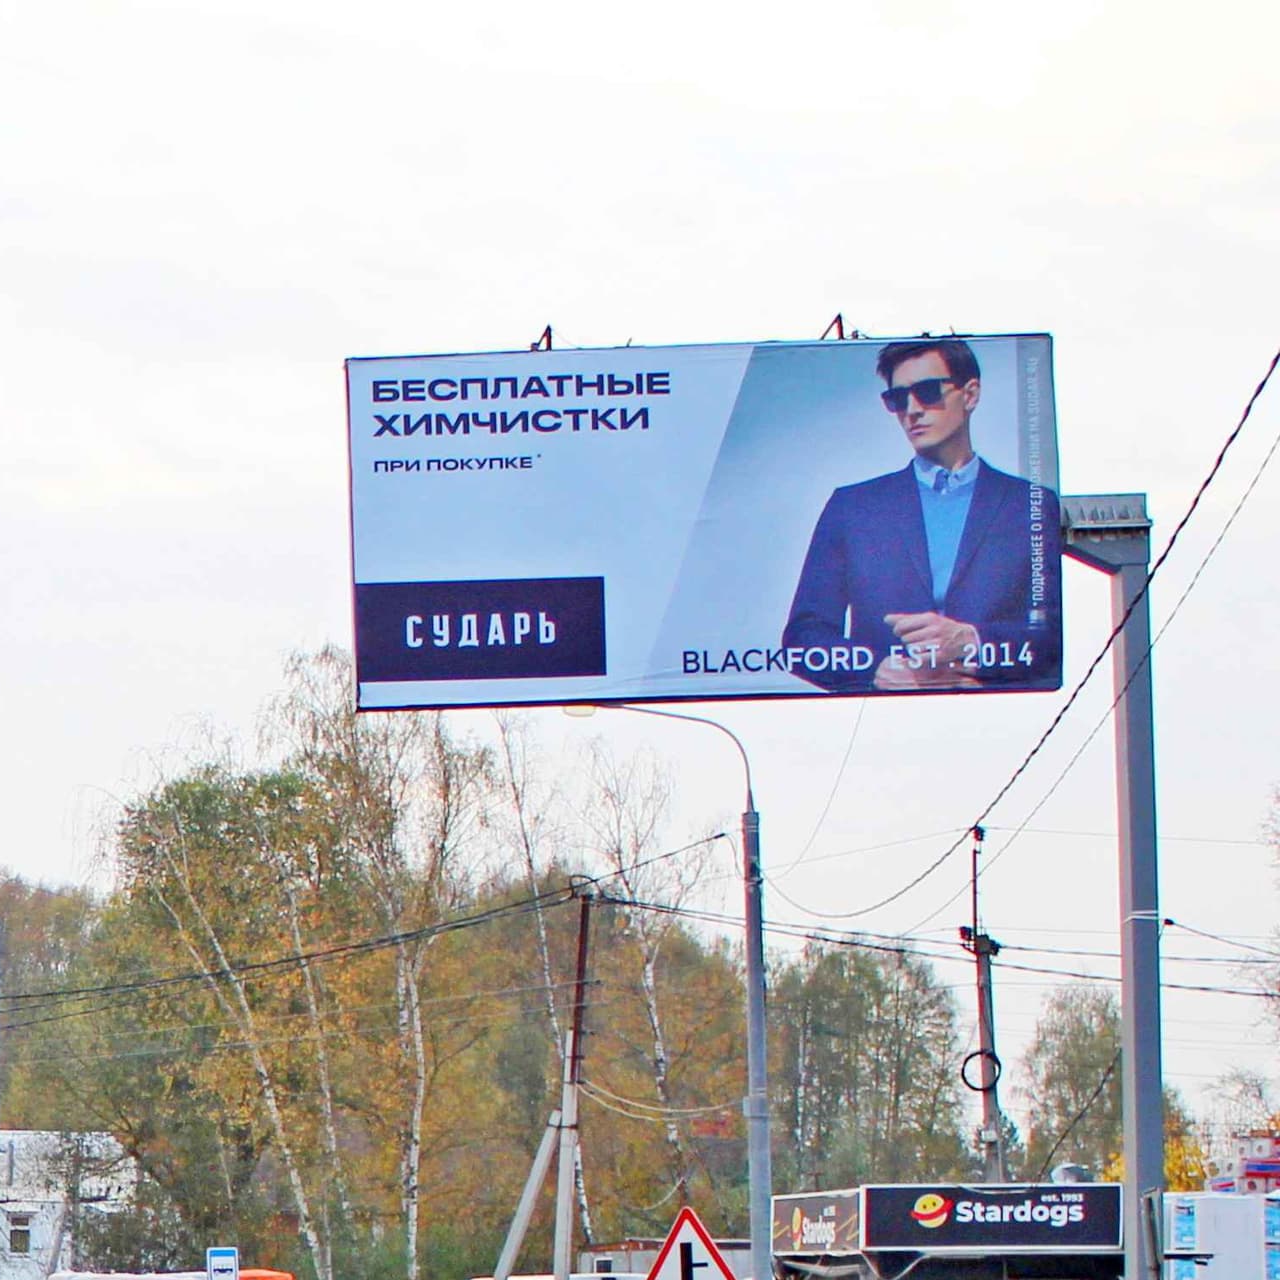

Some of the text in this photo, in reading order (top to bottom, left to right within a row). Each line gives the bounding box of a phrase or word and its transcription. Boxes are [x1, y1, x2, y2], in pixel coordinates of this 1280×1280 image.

[371, 371, 671, 403] БЕСПЛАТНЫЕ
[372, 407, 650, 437] ХИМЧИСТКИ
[373, 460, 421, 473] ПРИ
[405, 611, 557, 648] СУДАРЬ
[682, 645, 874, 674] BLACKFORD
[956, 1200, 1085, 1227] Stardogs
